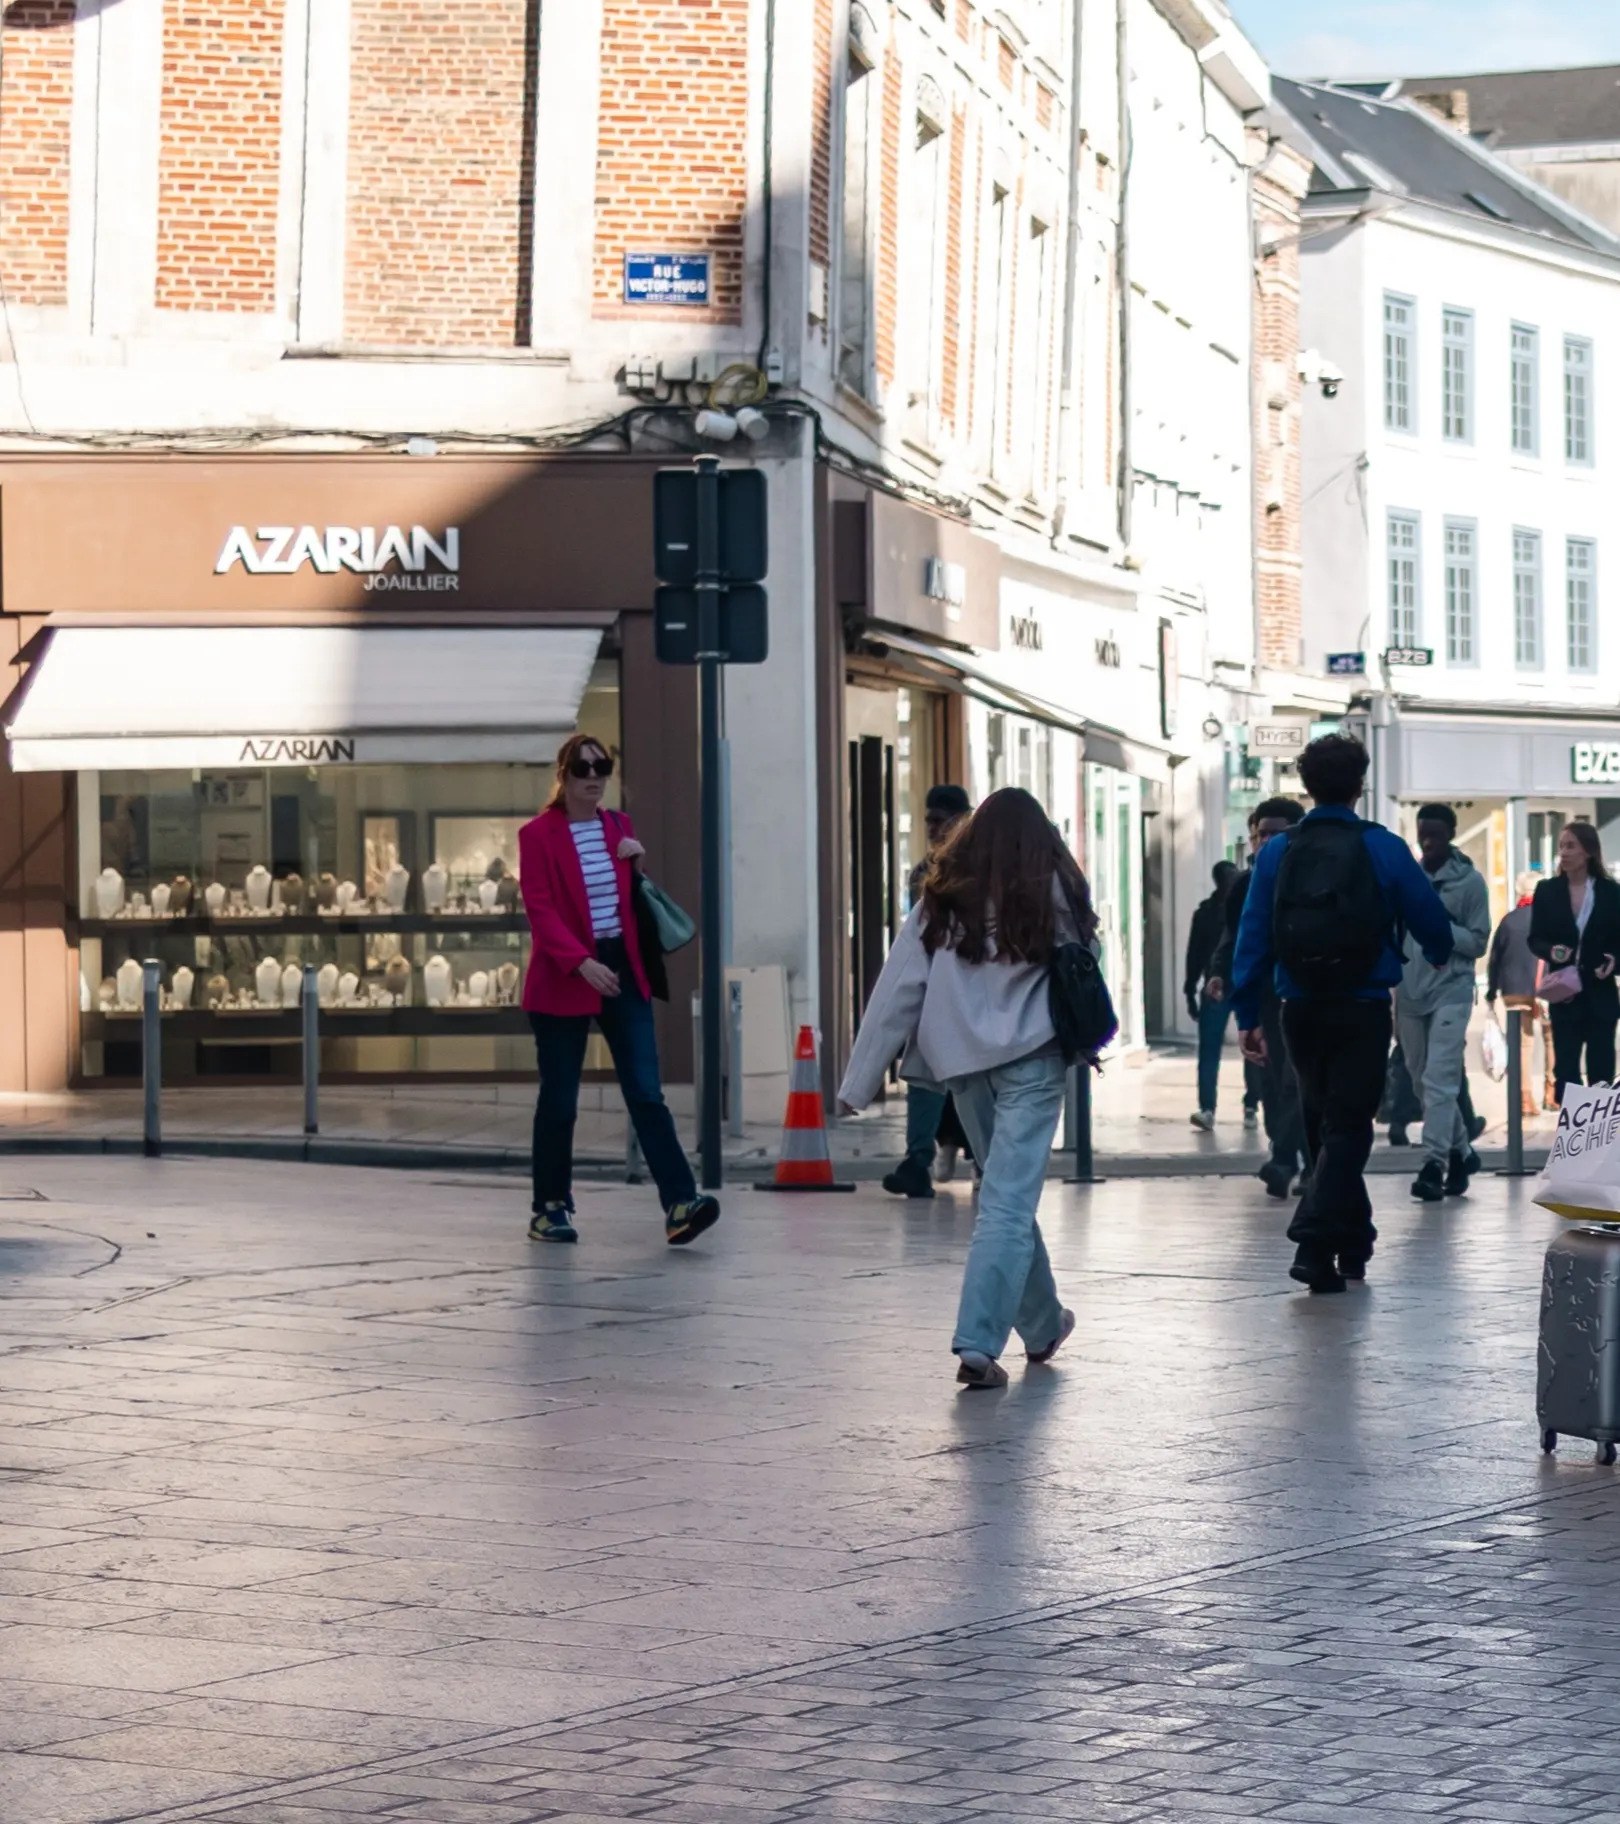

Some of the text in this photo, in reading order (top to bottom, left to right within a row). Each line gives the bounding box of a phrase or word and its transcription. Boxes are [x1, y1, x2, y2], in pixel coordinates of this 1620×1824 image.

[653, 264, 682, 279] RUE
[628, 278, 706, 294] VICTOR-HUGO
[214, 525, 460, 574] AZARIAN
[363, 574, 460, 592] JOAILLIER
[1260, 731, 1298, 743] HYPE
[239, 738, 356, 762] AZARIAN
